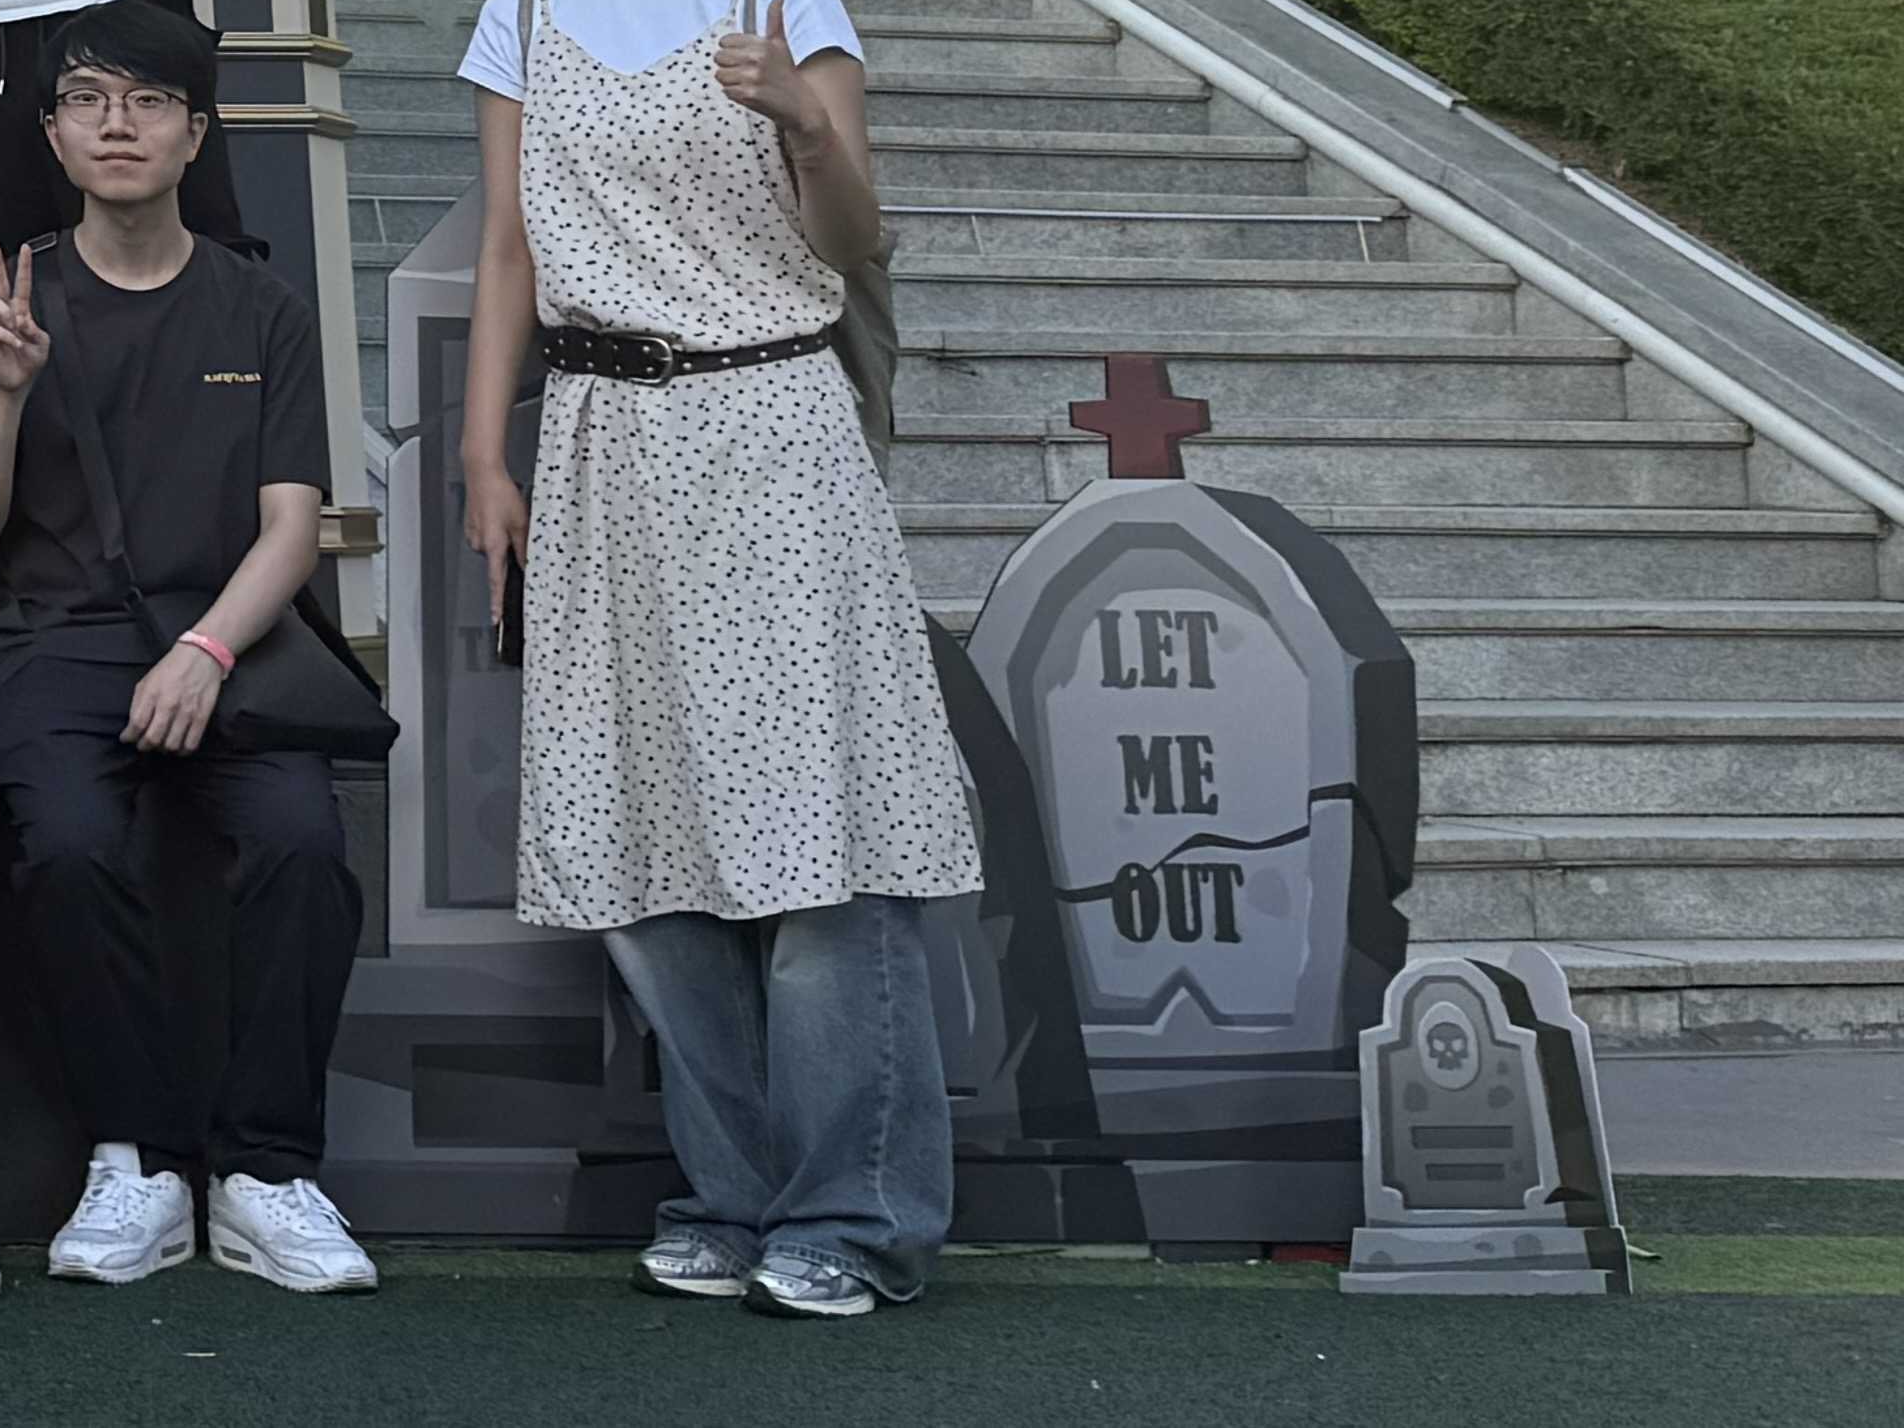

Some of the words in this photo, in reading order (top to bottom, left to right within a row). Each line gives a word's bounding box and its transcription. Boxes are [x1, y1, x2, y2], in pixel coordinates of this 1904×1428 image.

[1096, 609, 1218, 690] LET
[1117, 734, 1219, 816] ME
[1111, 861, 1246, 945] OUT
